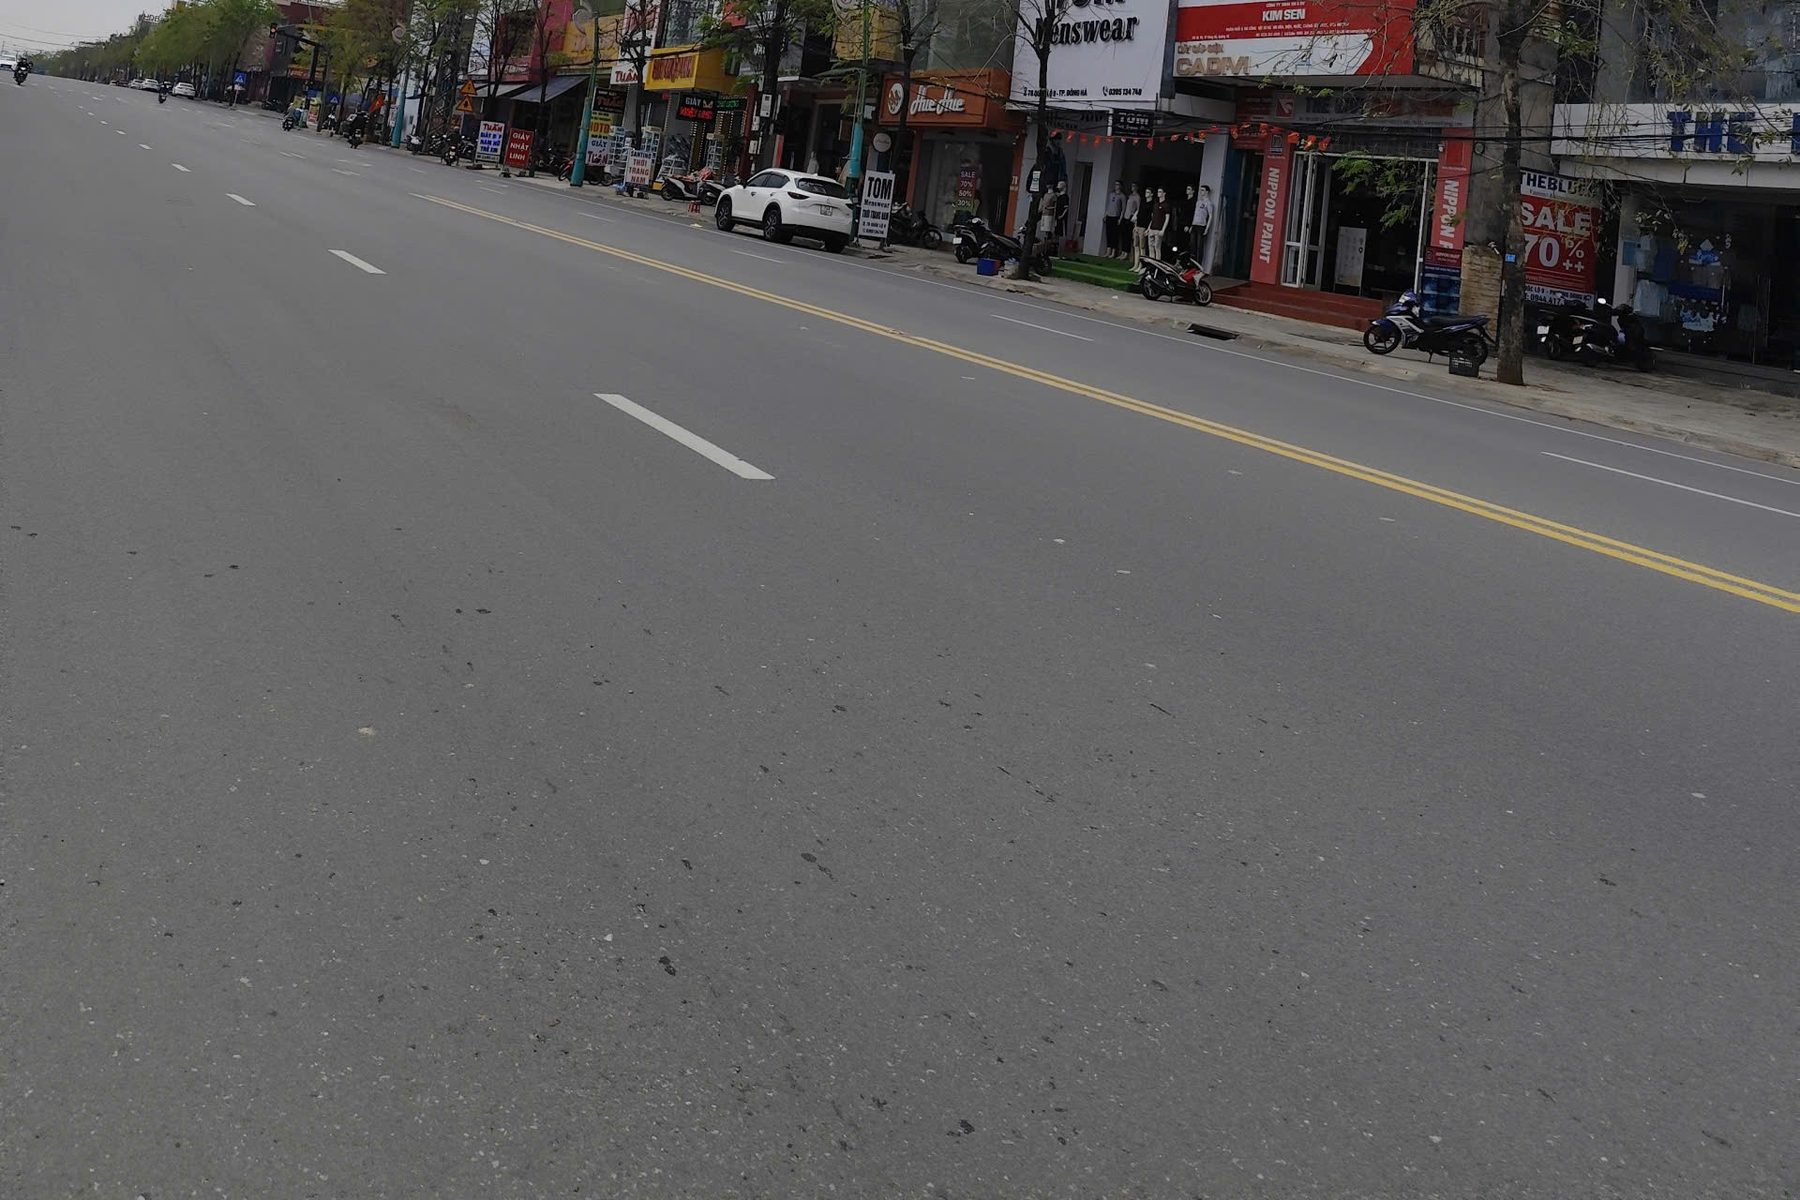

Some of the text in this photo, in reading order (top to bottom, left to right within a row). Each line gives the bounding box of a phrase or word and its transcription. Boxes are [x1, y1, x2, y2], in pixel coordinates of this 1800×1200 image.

[1262, 9, 1306, 22] KIM SEN
[1667, 111, 1755, 154] THE
[867, 176, 893, 200] TOM
[1264, 167, 1280, 217] NIPPON
[1440, 180, 1460, 239] NIPPON
[1521, 202, 1591, 237] SALE
[1259, 222, 1275, 264] PAINT
